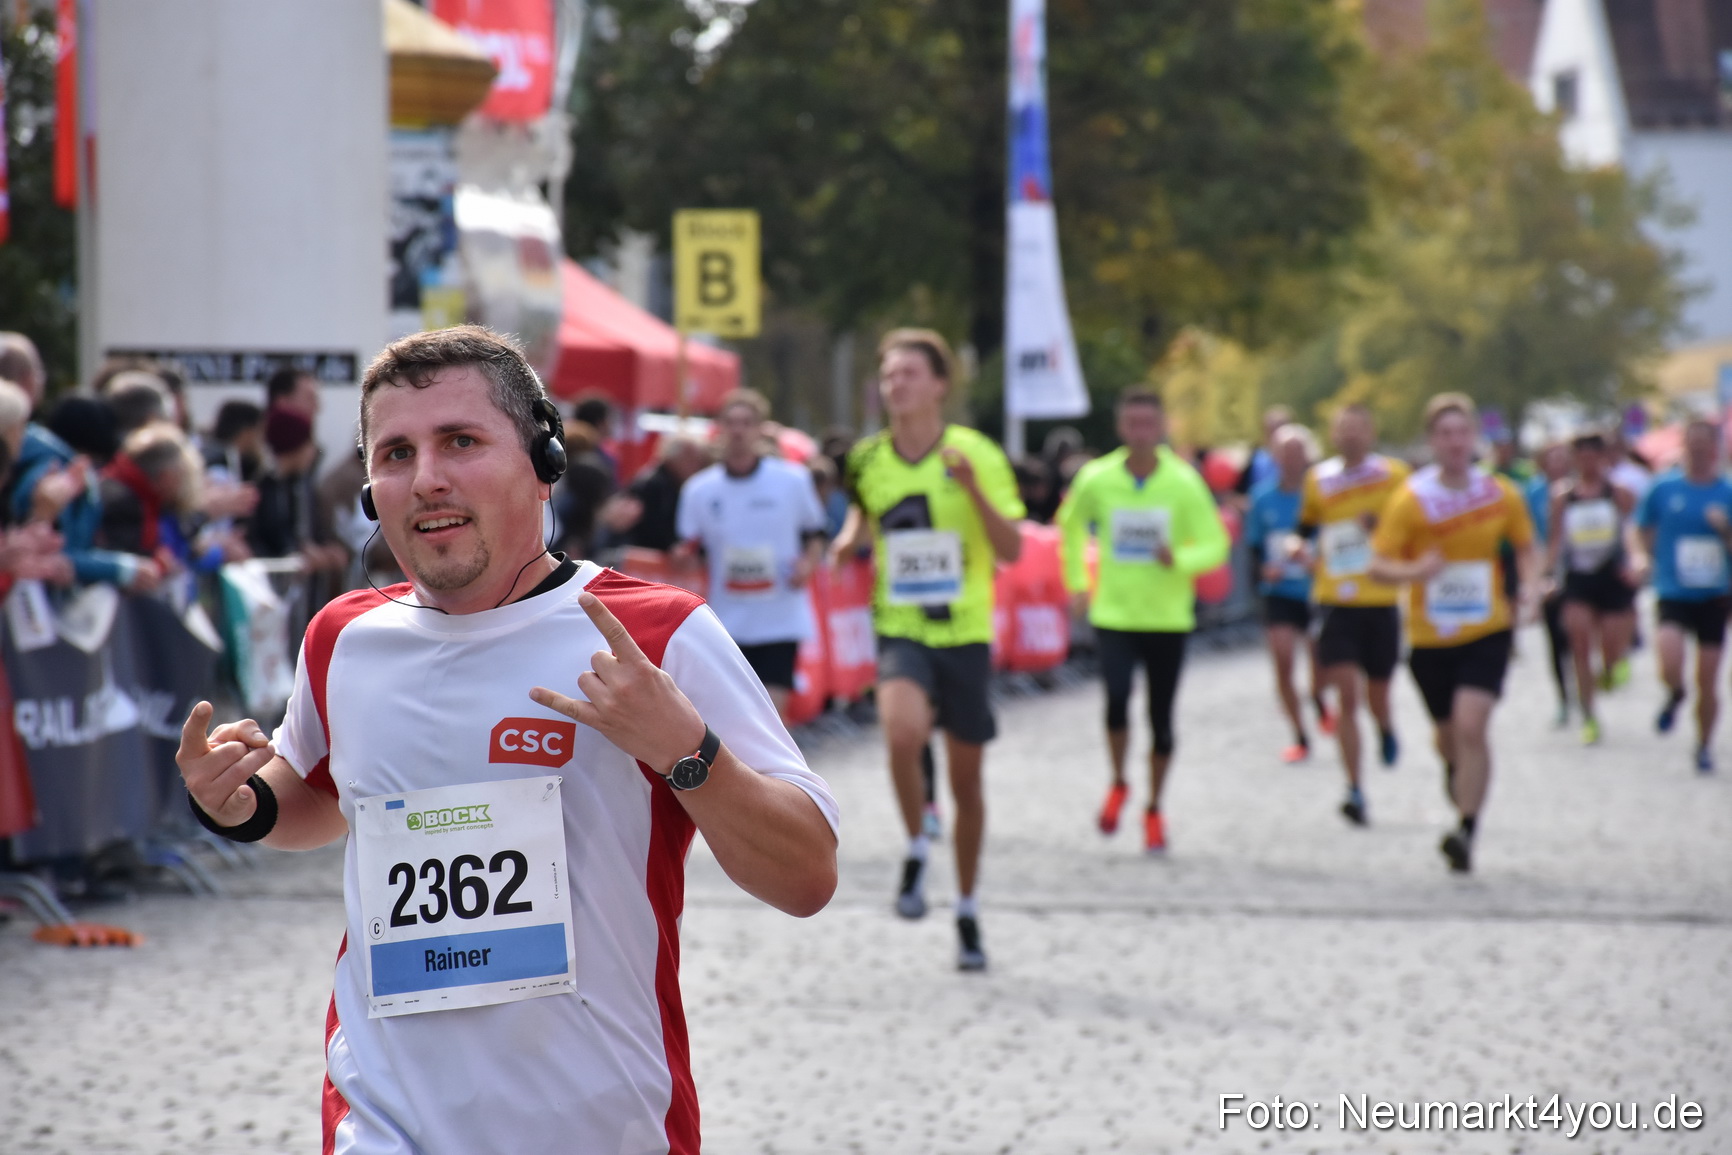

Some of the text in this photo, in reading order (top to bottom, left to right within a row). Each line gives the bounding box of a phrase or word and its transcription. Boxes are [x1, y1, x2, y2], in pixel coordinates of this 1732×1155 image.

[698, 250, 737, 308] B
[499, 728, 564, 756] CSC
[424, 804, 492, 828] BOCK
[424, 828, 443, 836] inspired
[466, 823, 494, 831] concepts
[388, 850, 533, 928] 2362
[373, 922, 381, 935] C
[424, 947, 492, 973] Rainer
